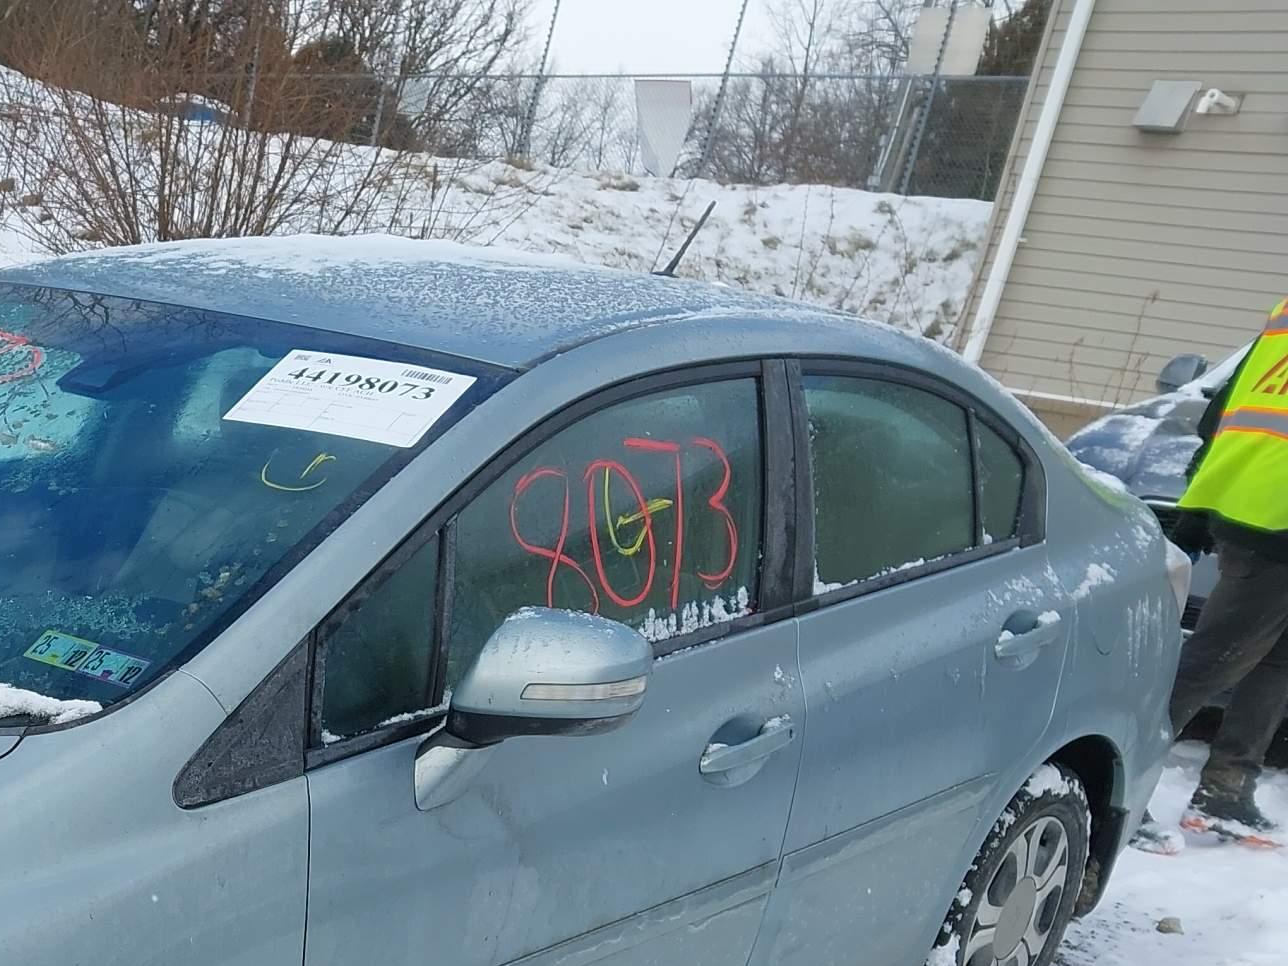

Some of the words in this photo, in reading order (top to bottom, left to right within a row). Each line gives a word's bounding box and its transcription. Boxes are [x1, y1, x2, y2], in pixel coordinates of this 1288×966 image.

[287, 366, 436, 401] 44198073
[509, 436, 739, 616] 8073
[31, 634, 59, 655] 25
[64, 649, 87, 668] 12
[83, 650, 112, 671] 25
[118, 665, 143, 685] 12
